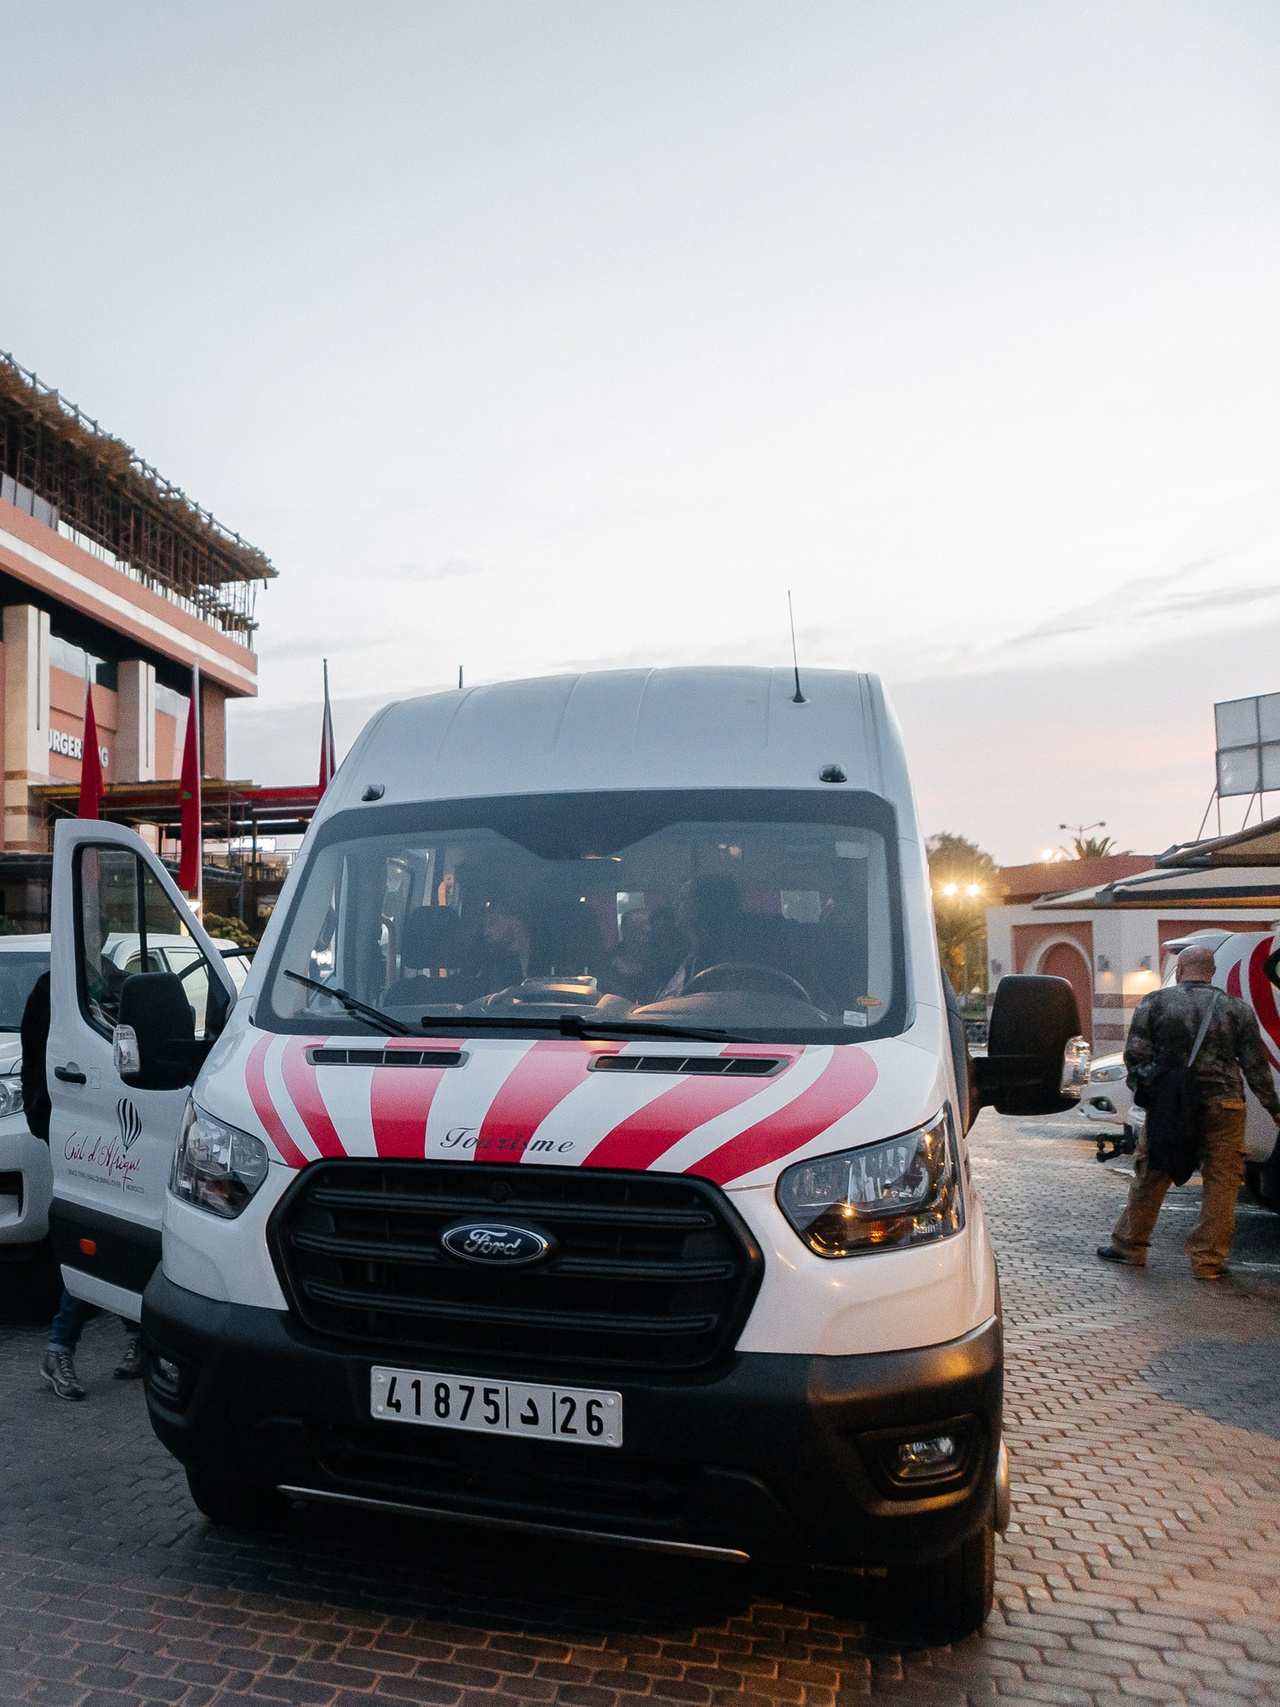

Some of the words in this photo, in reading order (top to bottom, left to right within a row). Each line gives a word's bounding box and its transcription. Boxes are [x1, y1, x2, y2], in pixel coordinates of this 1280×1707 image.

[440, 1127, 575, 1153] Tourisme
[463, 1229, 522, 1255] Ford
[386, 1376, 500, 1425] 41875
[560, 1396, 603, 1437] 26
